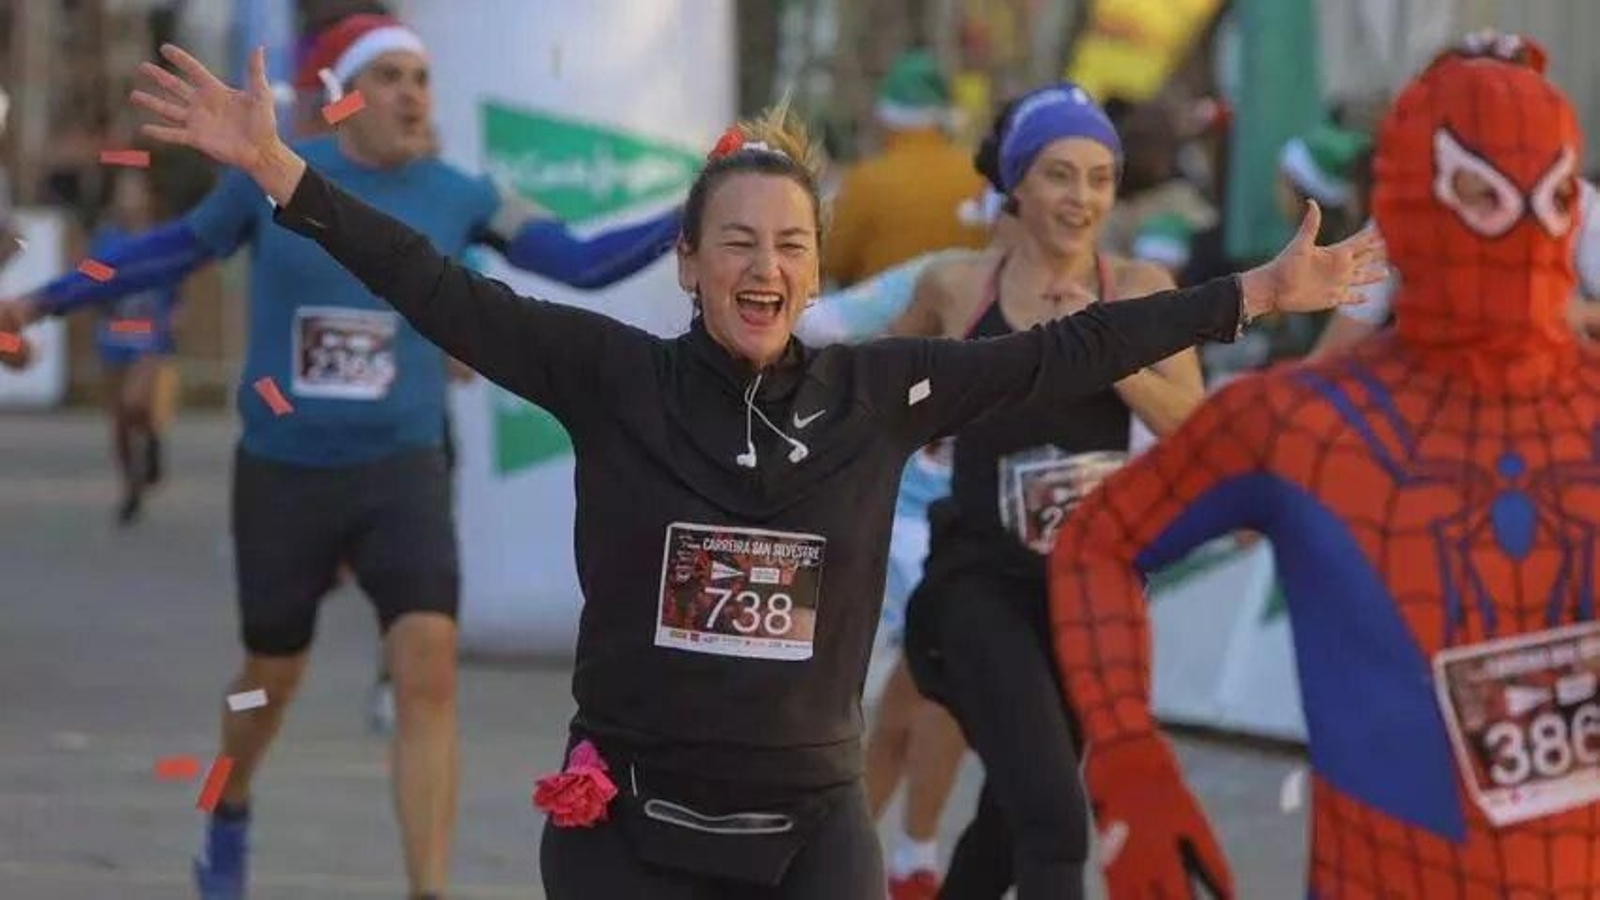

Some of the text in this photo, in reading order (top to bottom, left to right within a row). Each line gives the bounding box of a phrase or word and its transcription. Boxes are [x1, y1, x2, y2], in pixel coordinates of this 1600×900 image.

[703, 537, 819, 560] CARREIRA SAN SILVESTRE
[704, 587, 793, 635] 738
[1485, 703, 1600, 784] 386
